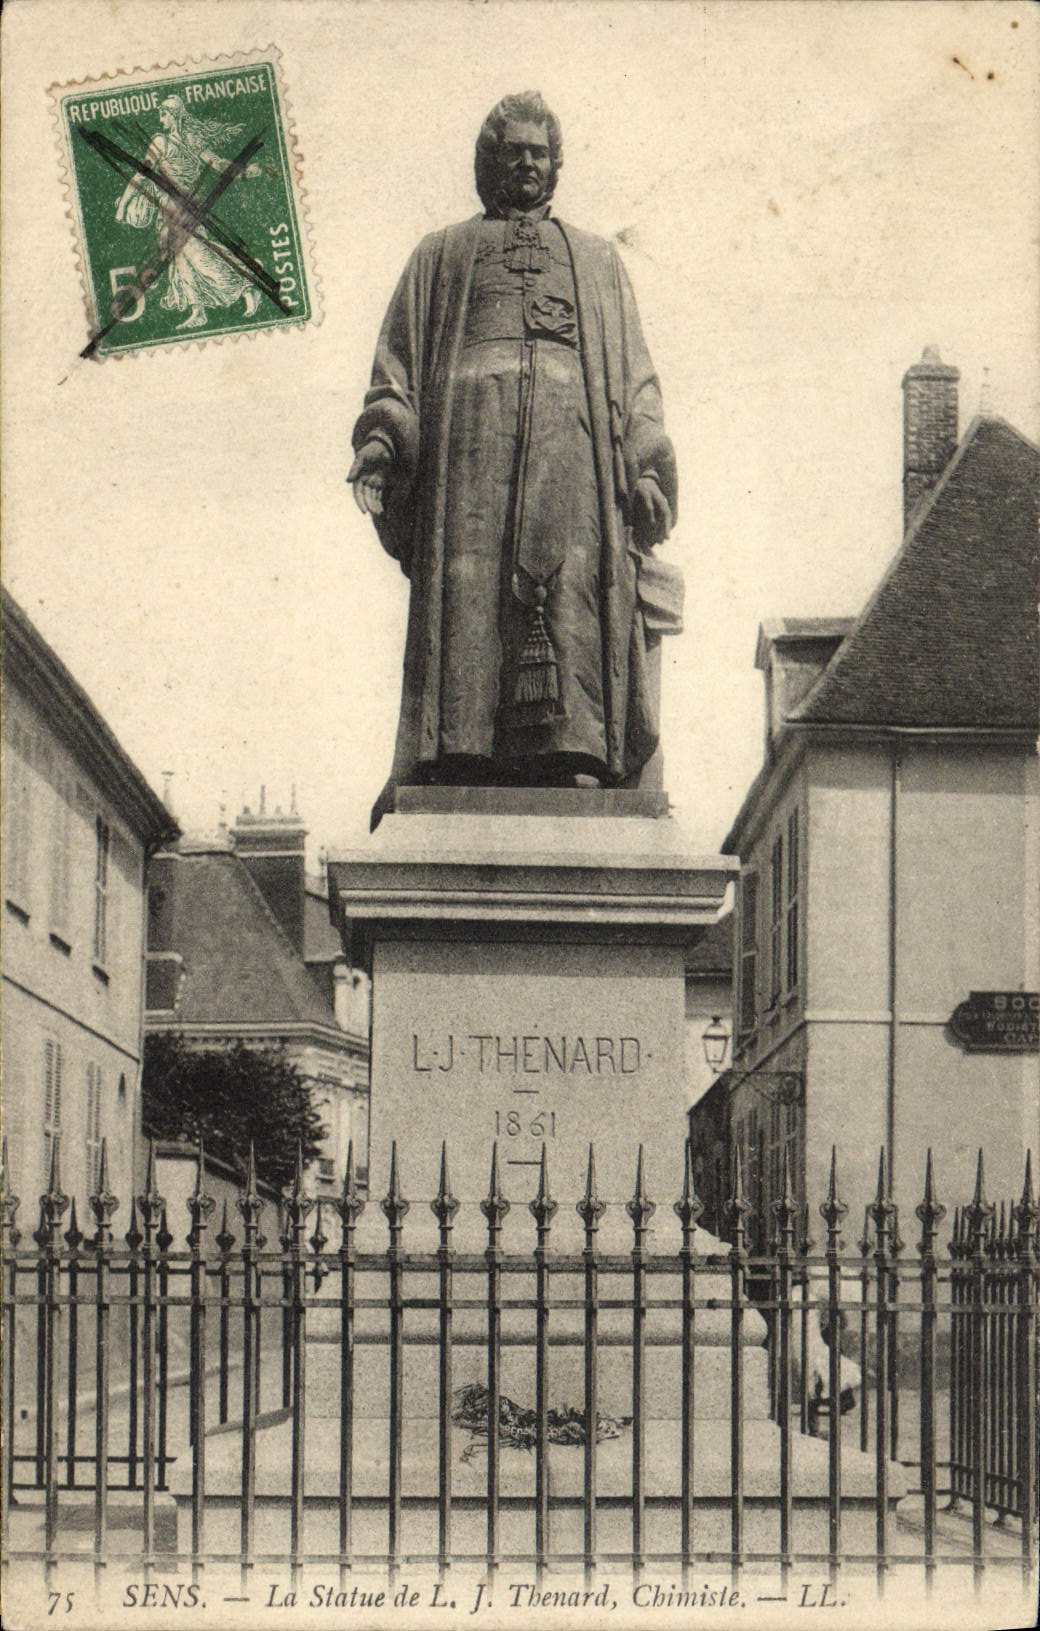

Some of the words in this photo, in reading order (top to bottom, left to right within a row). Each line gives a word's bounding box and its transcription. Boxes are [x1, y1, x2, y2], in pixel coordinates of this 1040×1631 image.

[184, 73, 267, 104] FRANÇAISE
[269, 223, 299, 307] POSTES
[495, 1110, 556, 1138] 1861
